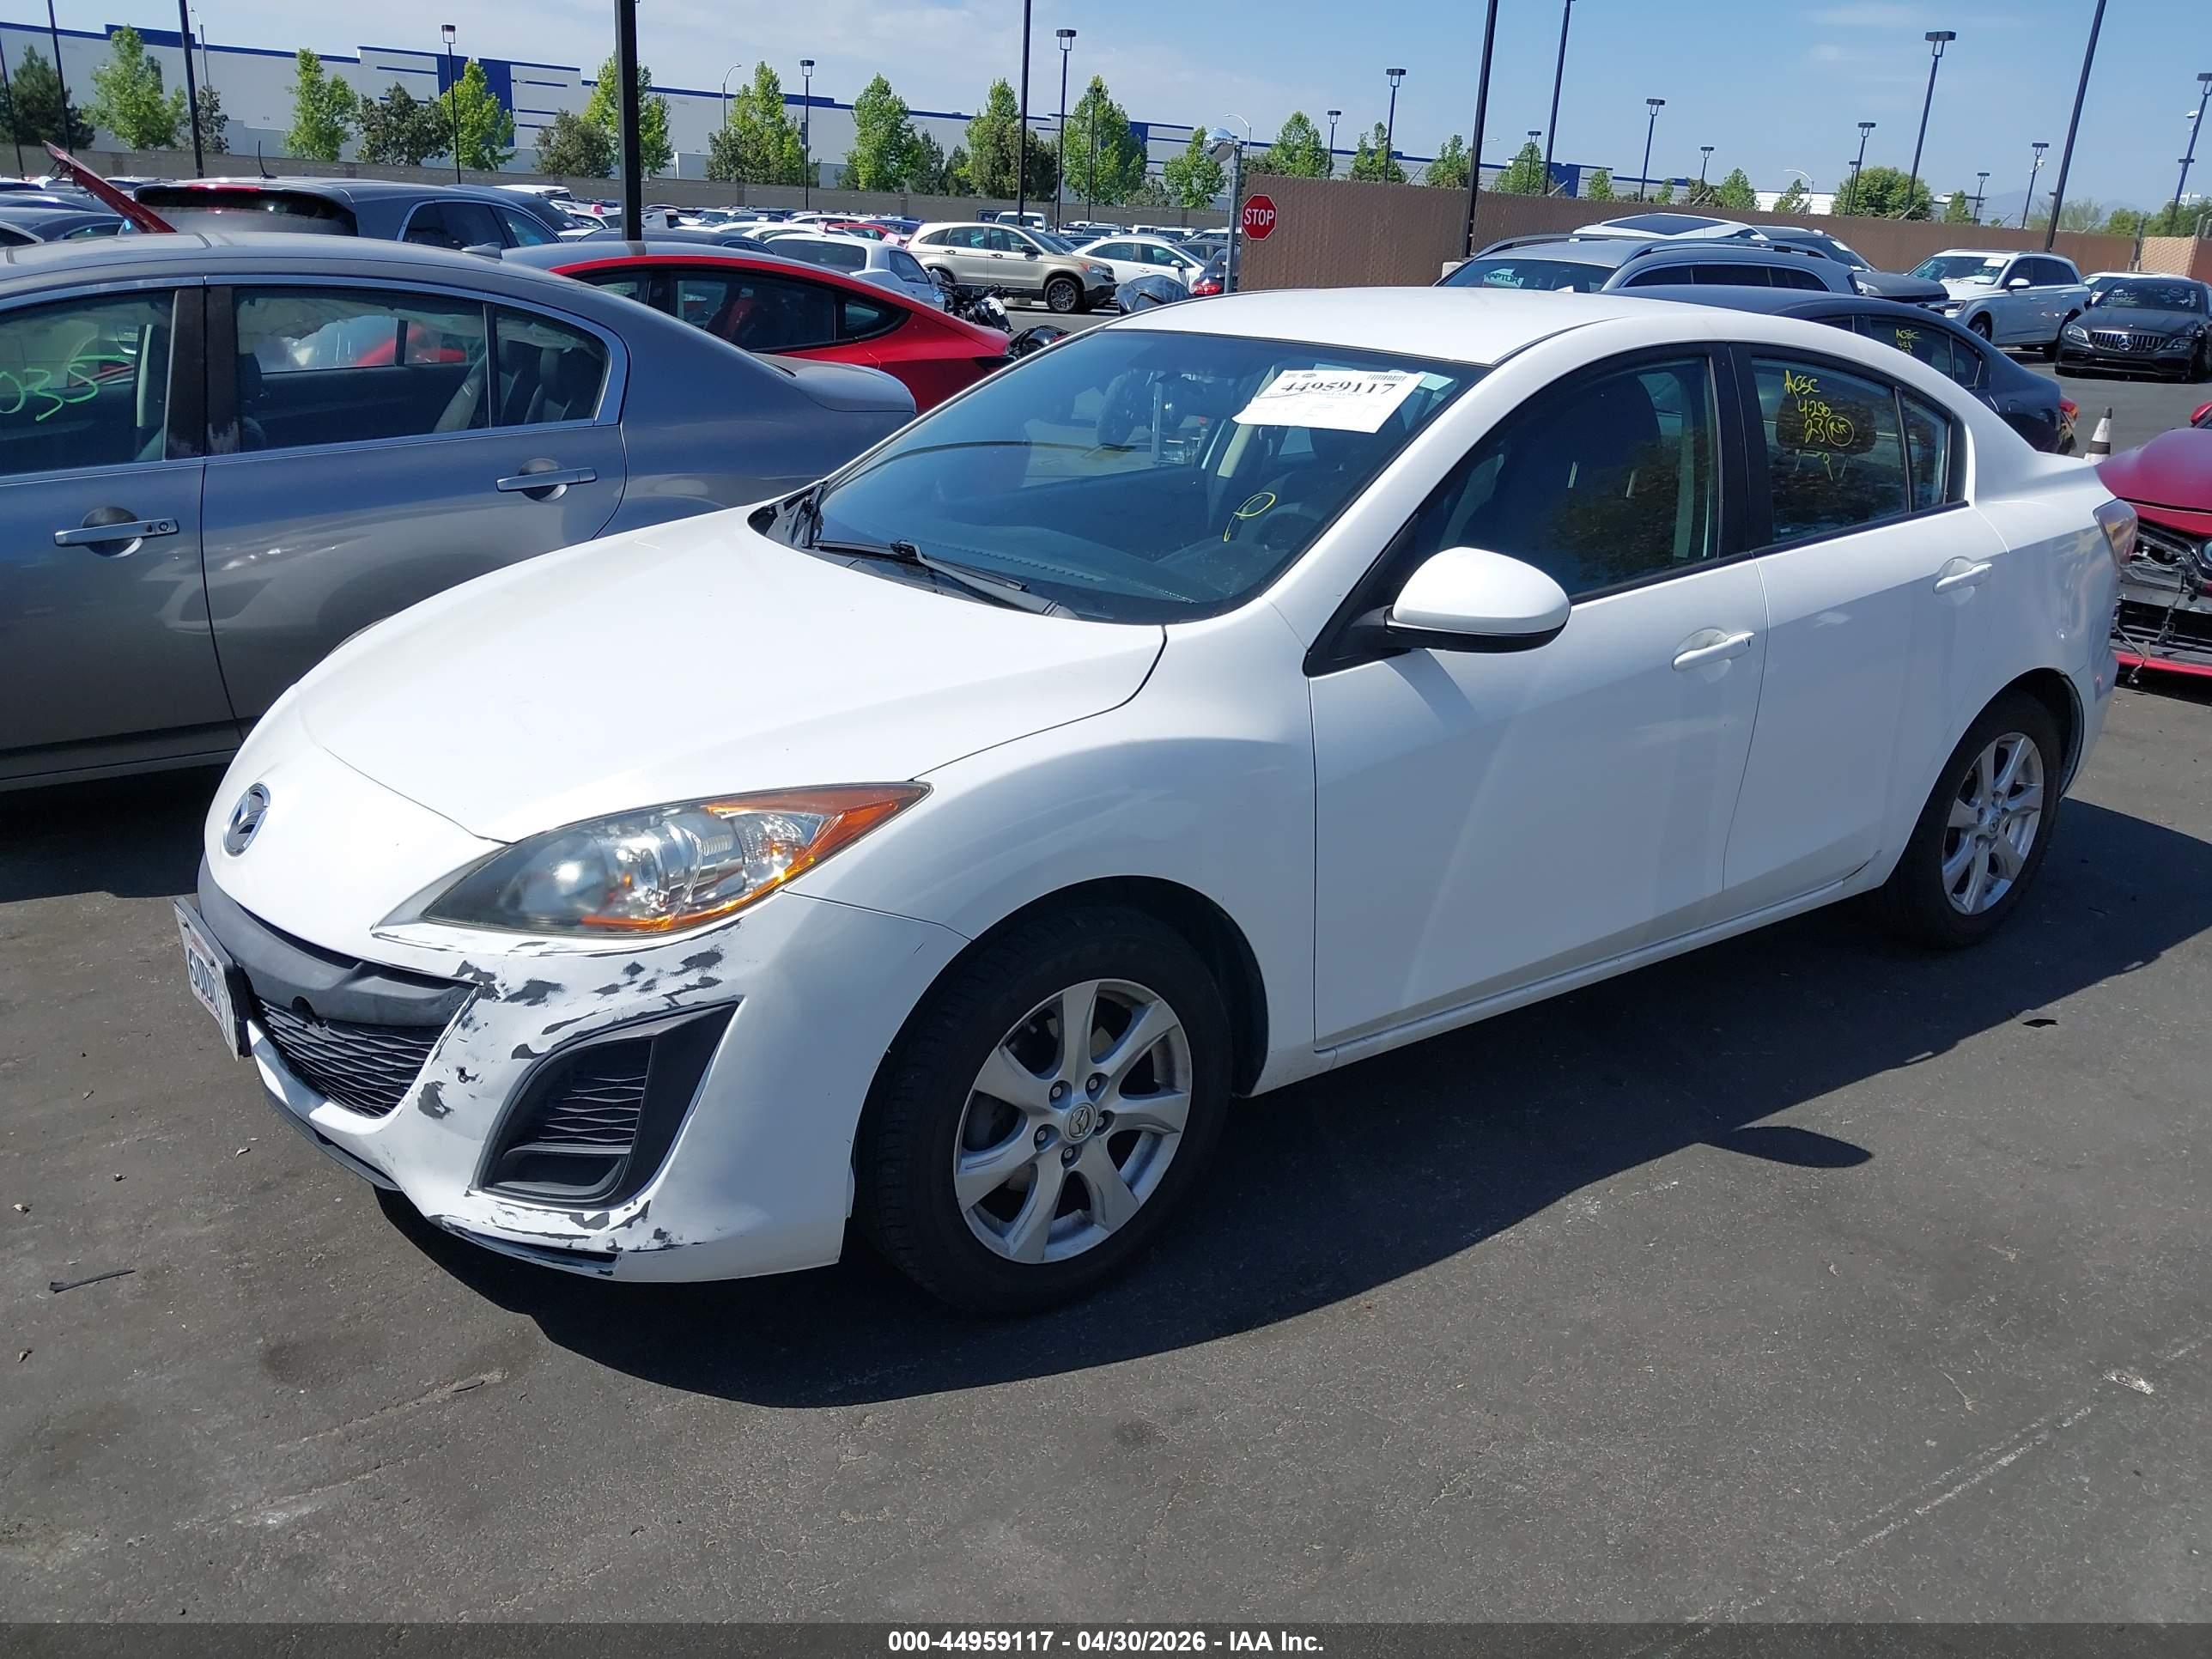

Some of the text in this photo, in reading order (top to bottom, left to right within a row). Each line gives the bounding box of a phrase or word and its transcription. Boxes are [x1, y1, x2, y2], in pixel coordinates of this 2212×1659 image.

[1243, 208, 1275, 226] STOP
[1485, 272, 1521, 285] RAPTOR
[1280, 380, 1398, 395] 44959117
